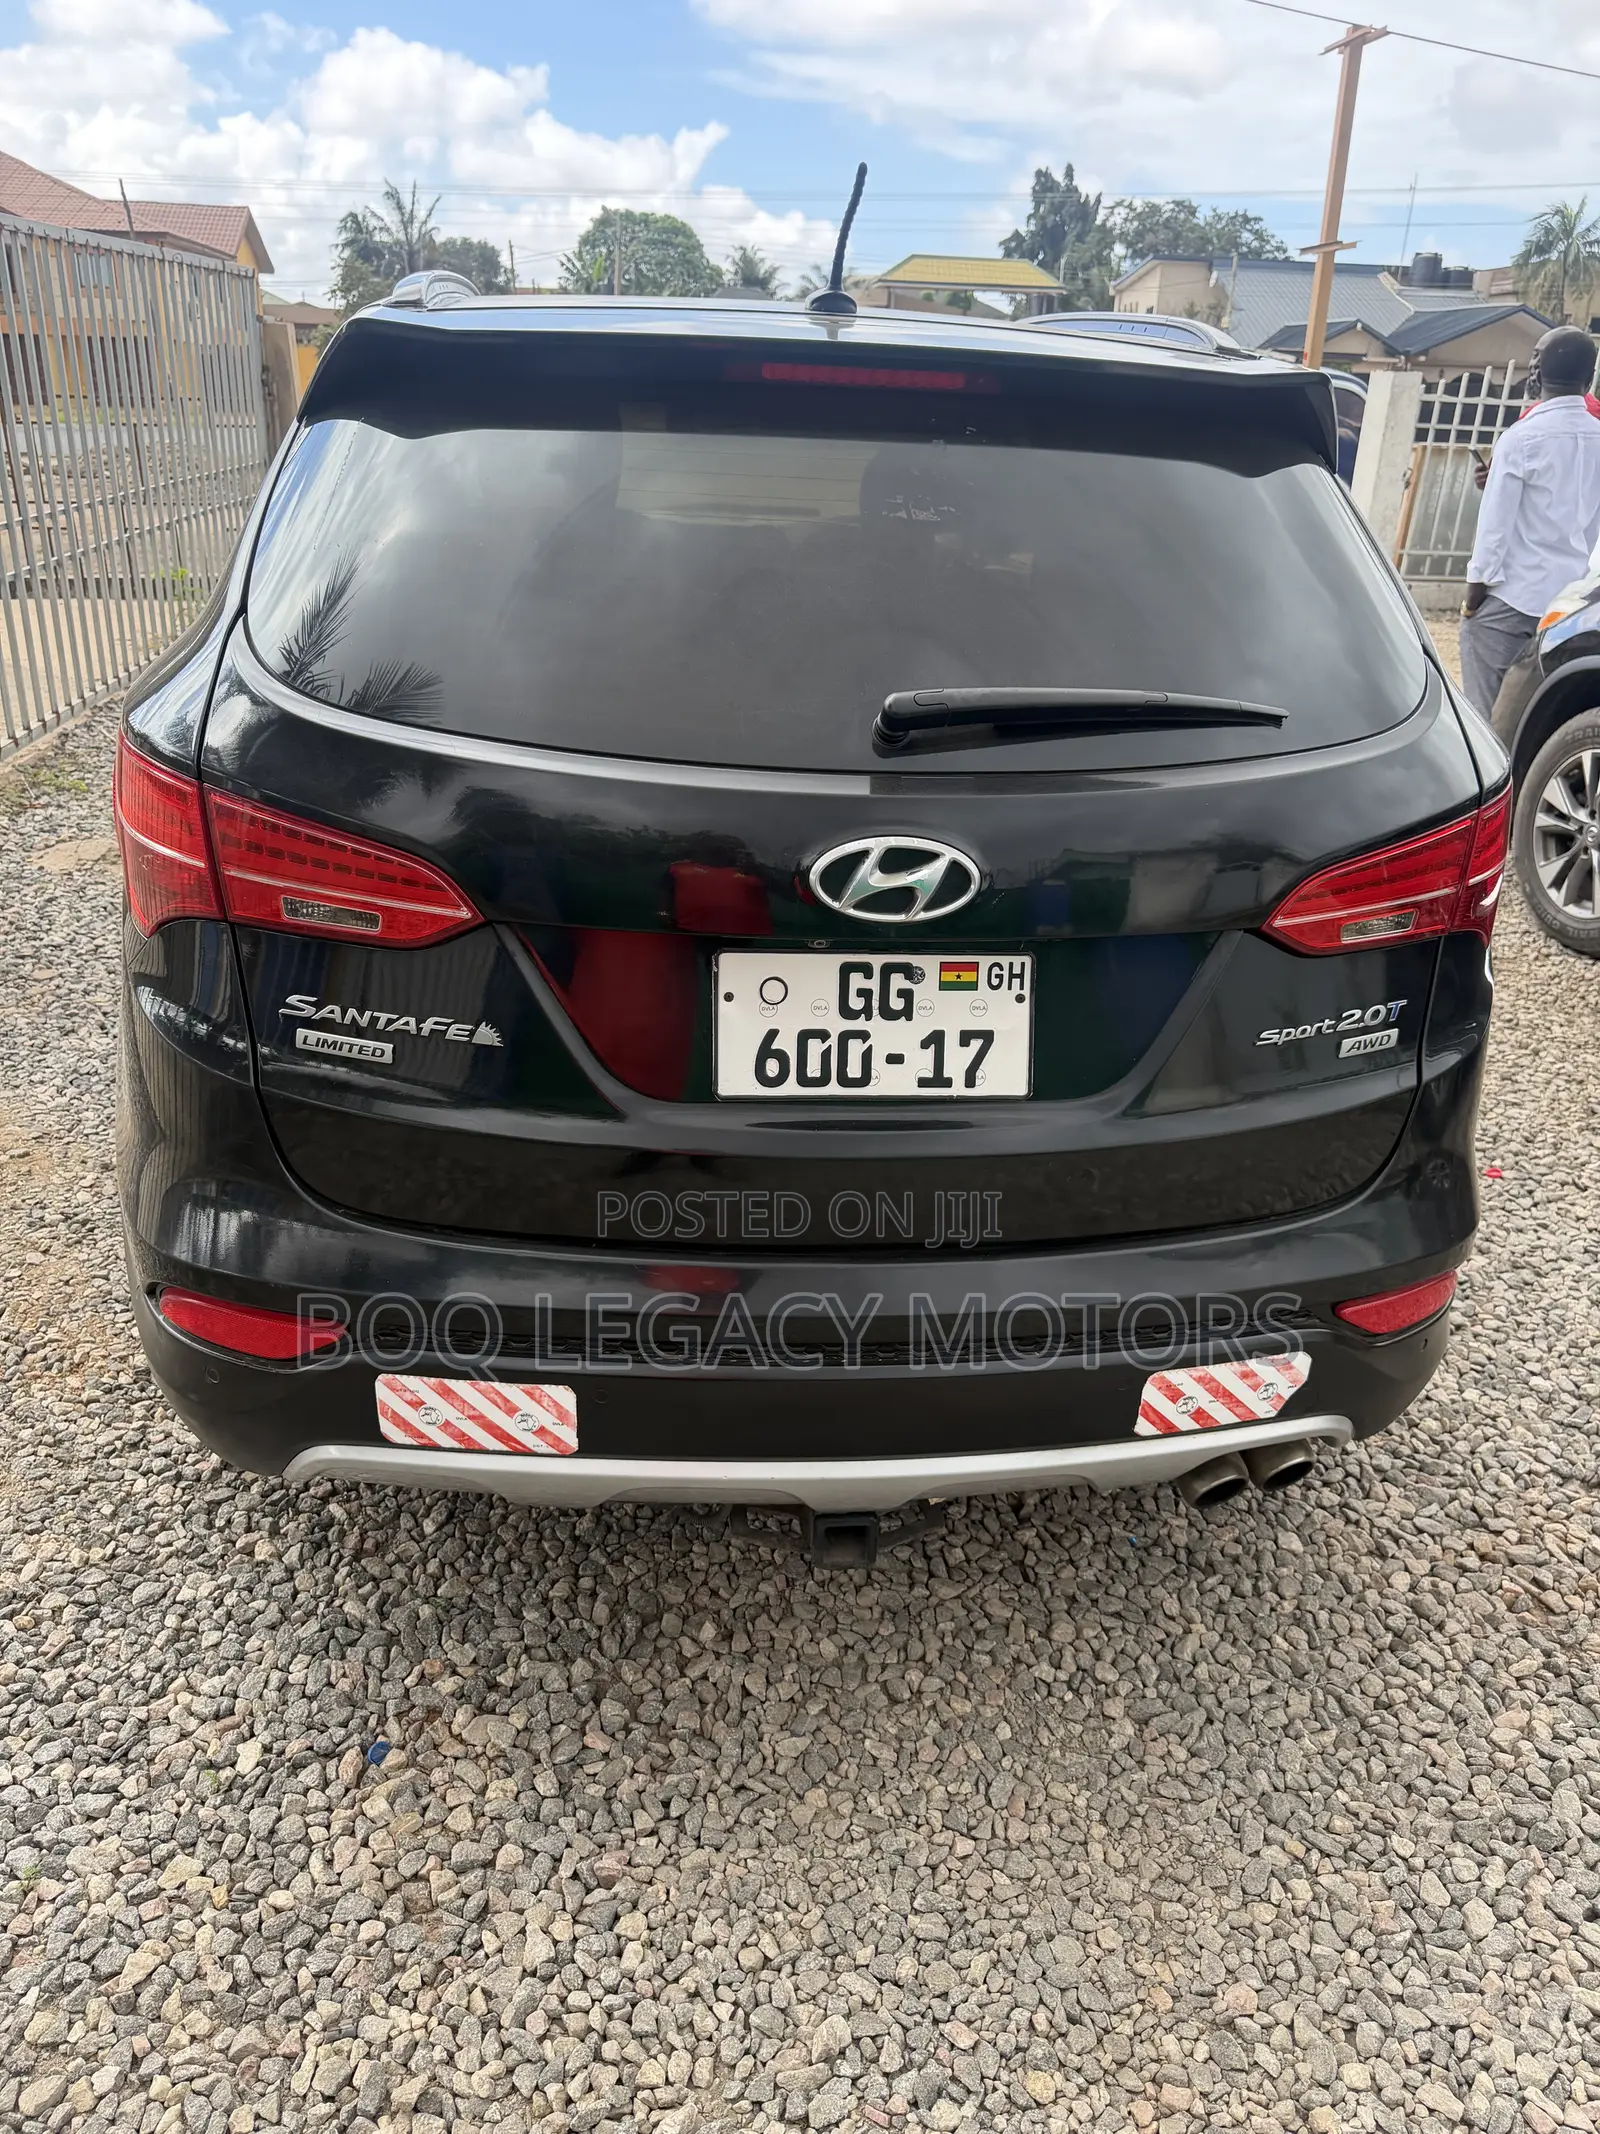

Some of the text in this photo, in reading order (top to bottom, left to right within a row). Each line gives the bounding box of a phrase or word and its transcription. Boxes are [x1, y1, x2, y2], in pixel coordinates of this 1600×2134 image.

[1565, 727, 1600, 743] TRAI
[1566, 926, 1600, 939] RAIL
[987, 962, 1025, 990] GH
[839, 962, 914, 1021] GG
[302, 1035, 386, 1059] LIMITED
[1346, 1034, 1392, 1054] AWD
[755, 1029, 994, 1088] 600-17
